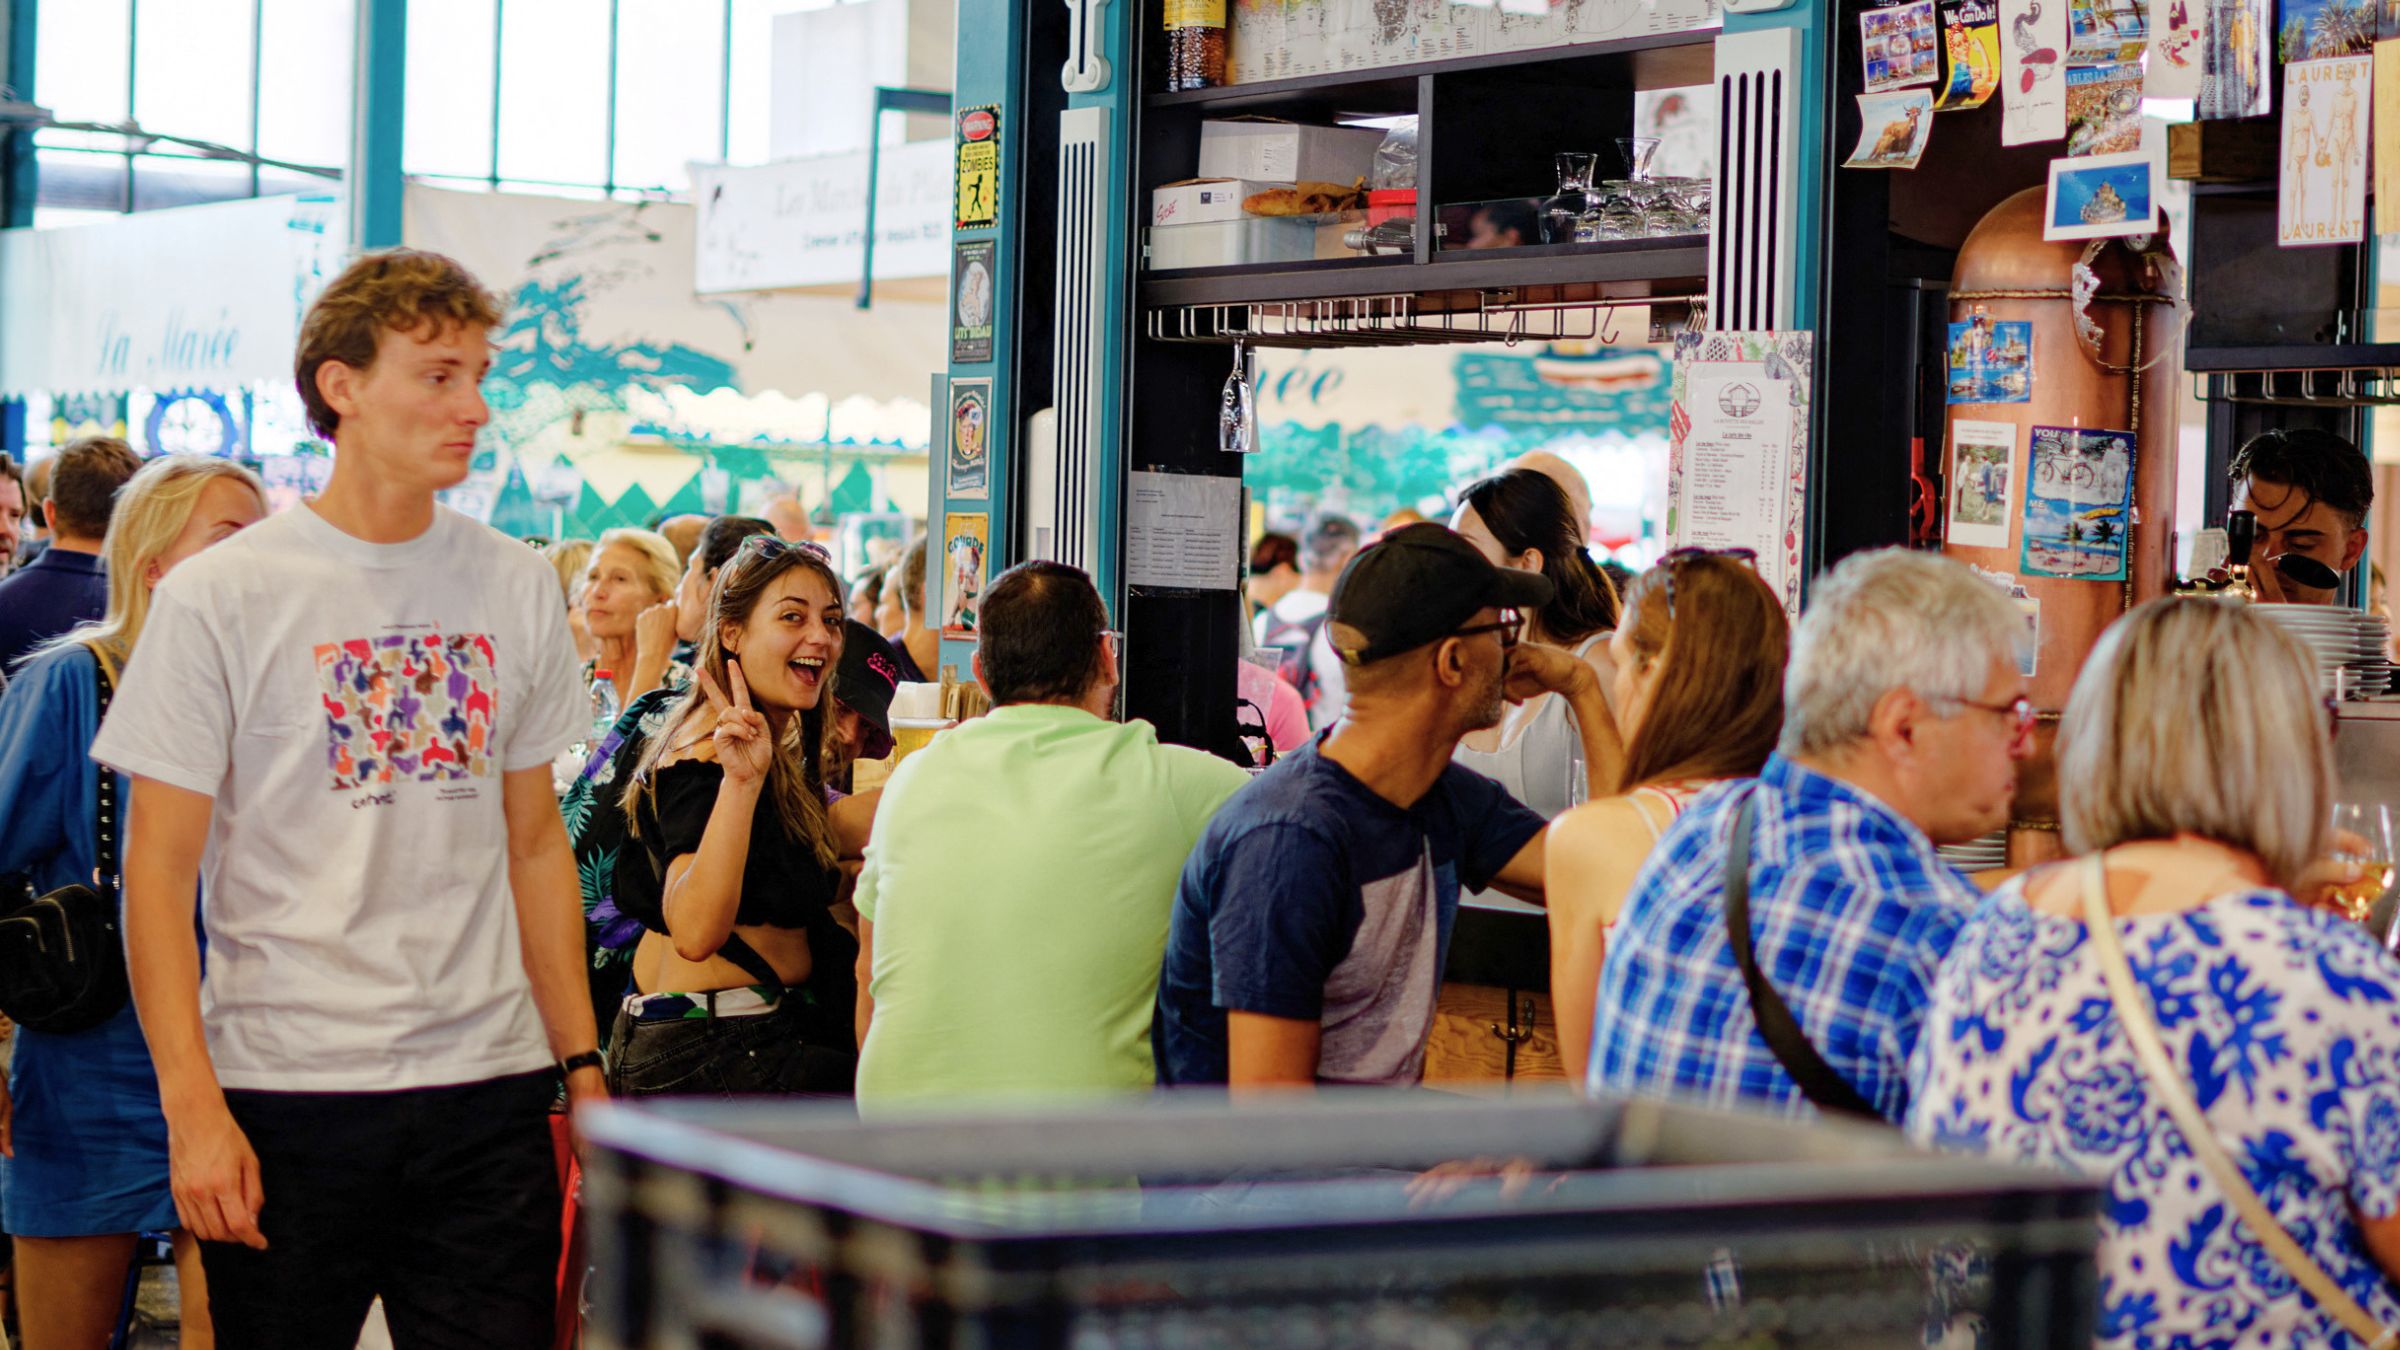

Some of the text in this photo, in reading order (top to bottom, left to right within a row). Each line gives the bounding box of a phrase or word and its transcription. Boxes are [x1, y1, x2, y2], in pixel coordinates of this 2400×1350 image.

[1944, 4, 1996, 25] We Can Do It!
[2287, 62, 2369, 85] LAURENT
[961, 156, 994, 174] ZOMBIES
[2281, 221, 2361, 240] LAURENT
